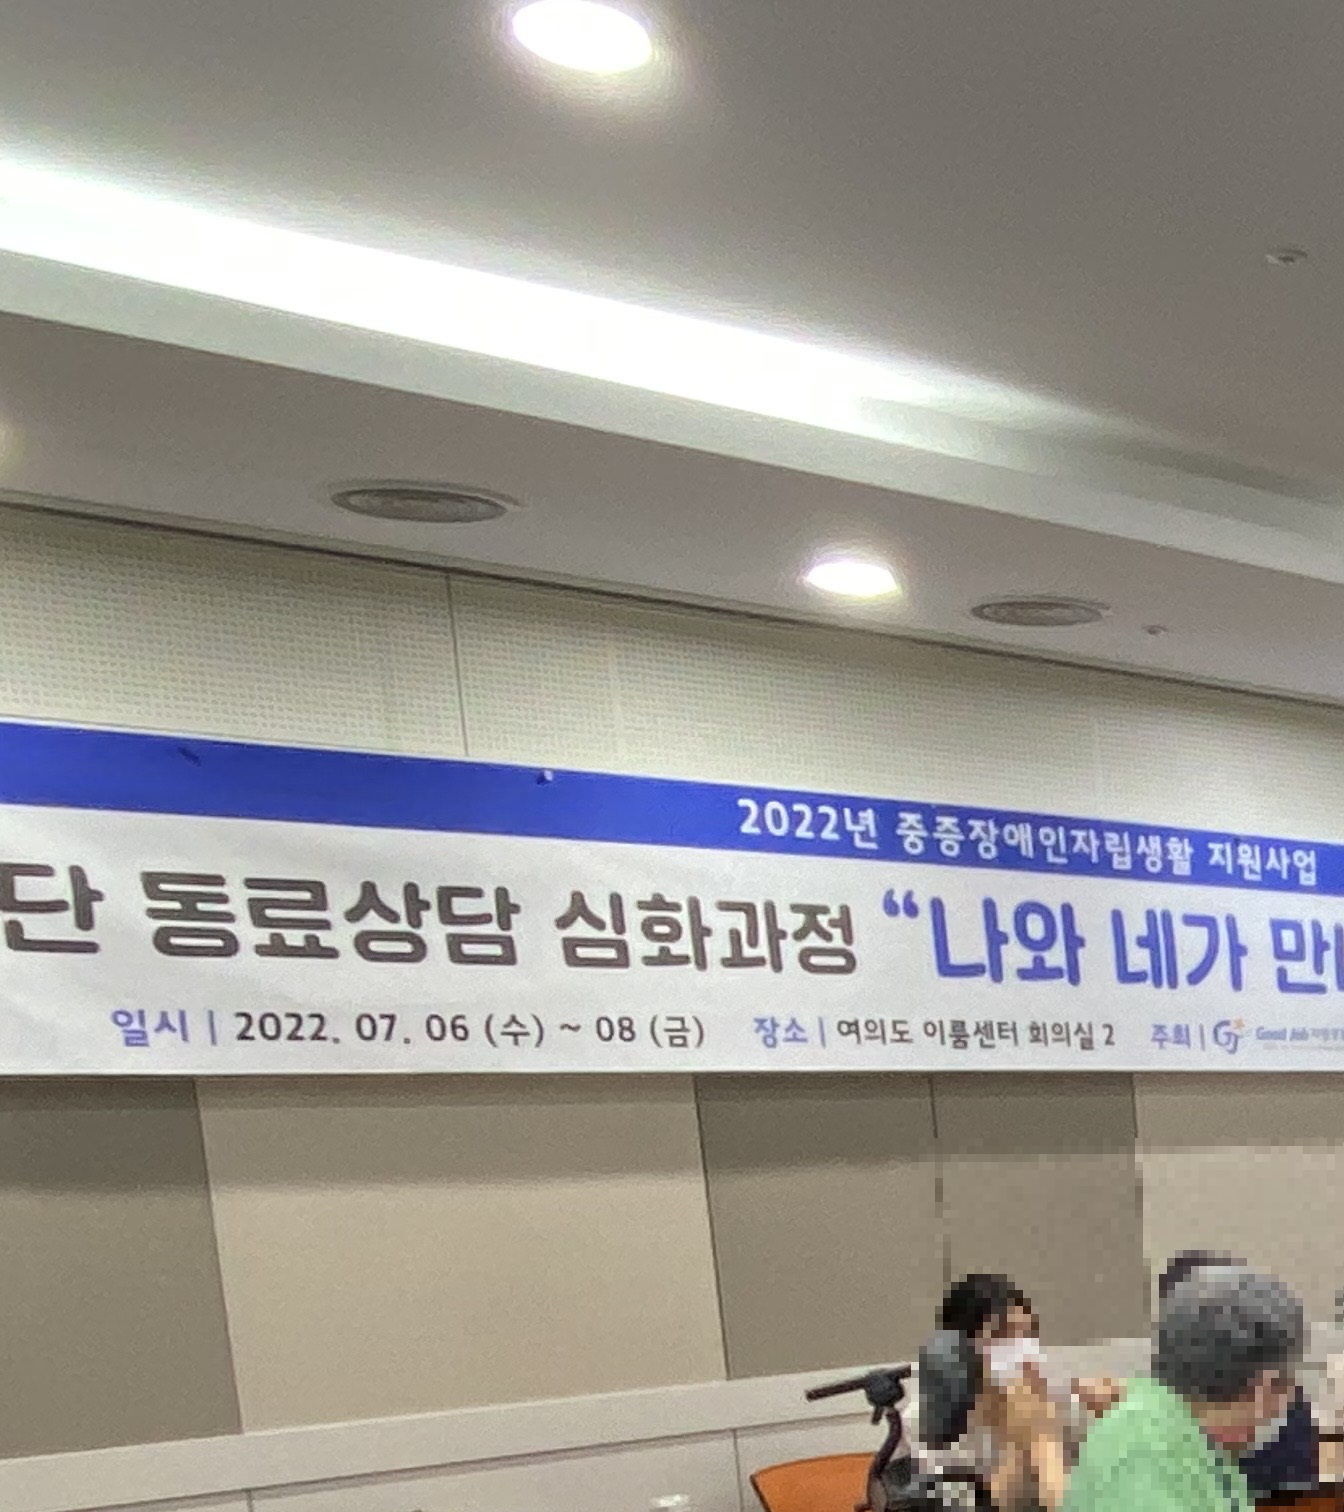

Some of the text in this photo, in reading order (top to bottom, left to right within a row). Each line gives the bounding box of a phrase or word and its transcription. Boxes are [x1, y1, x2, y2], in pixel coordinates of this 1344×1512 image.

[737, 798, 1318, 886] 2022년 중증장애인자립생활 지원사업
[0, 862, 104, 954] 단
[141, 870, 521, 966] 동료상담
[554, 890, 858, 975] 심화과정
[1111, 908, 1249, 992] 네가
[111, 1009, 190, 1048] 일시
[234, 1011, 340, 1044] 2022.
[355, 1013, 411, 1044] 07.
[425, 1013, 470, 1042] 06
[485, 1014, 545, 1048] (수)
[595, 1016, 637, 1043] 08
[650, 1015, 705, 1048] (금)
[752, 1016, 1116, 1051] 장소 여의도 이룸센터 회의실 2
